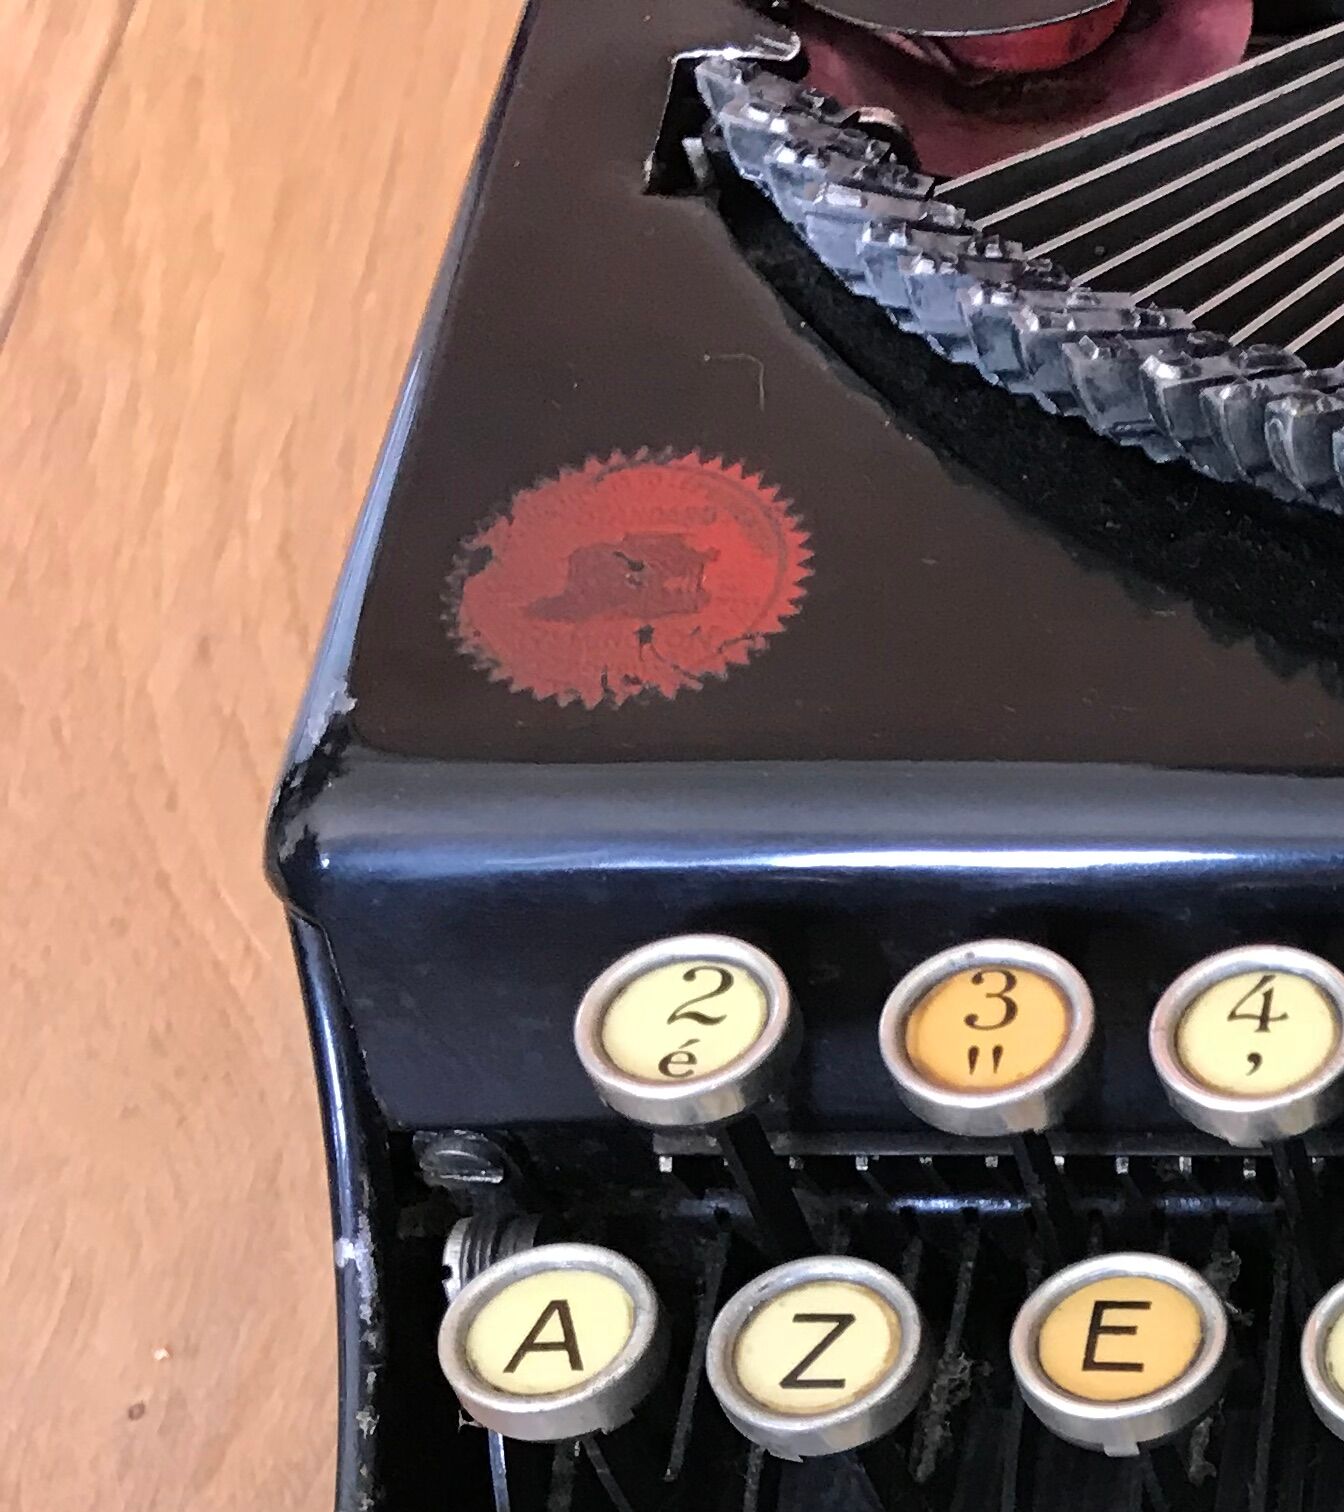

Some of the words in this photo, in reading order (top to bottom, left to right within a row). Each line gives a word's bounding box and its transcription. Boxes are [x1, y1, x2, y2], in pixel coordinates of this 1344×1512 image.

[666, 965, 734, 1025] 2
[963, 969, 1018, 1029] 3
[1227, 974, 1288, 1032] 4
[659, 1039, 696, 1077] é
[504, 1300, 583, 1373] A
[780, 1313, 855, 1389] Z
[1083, 1301, 1150, 1372] E
